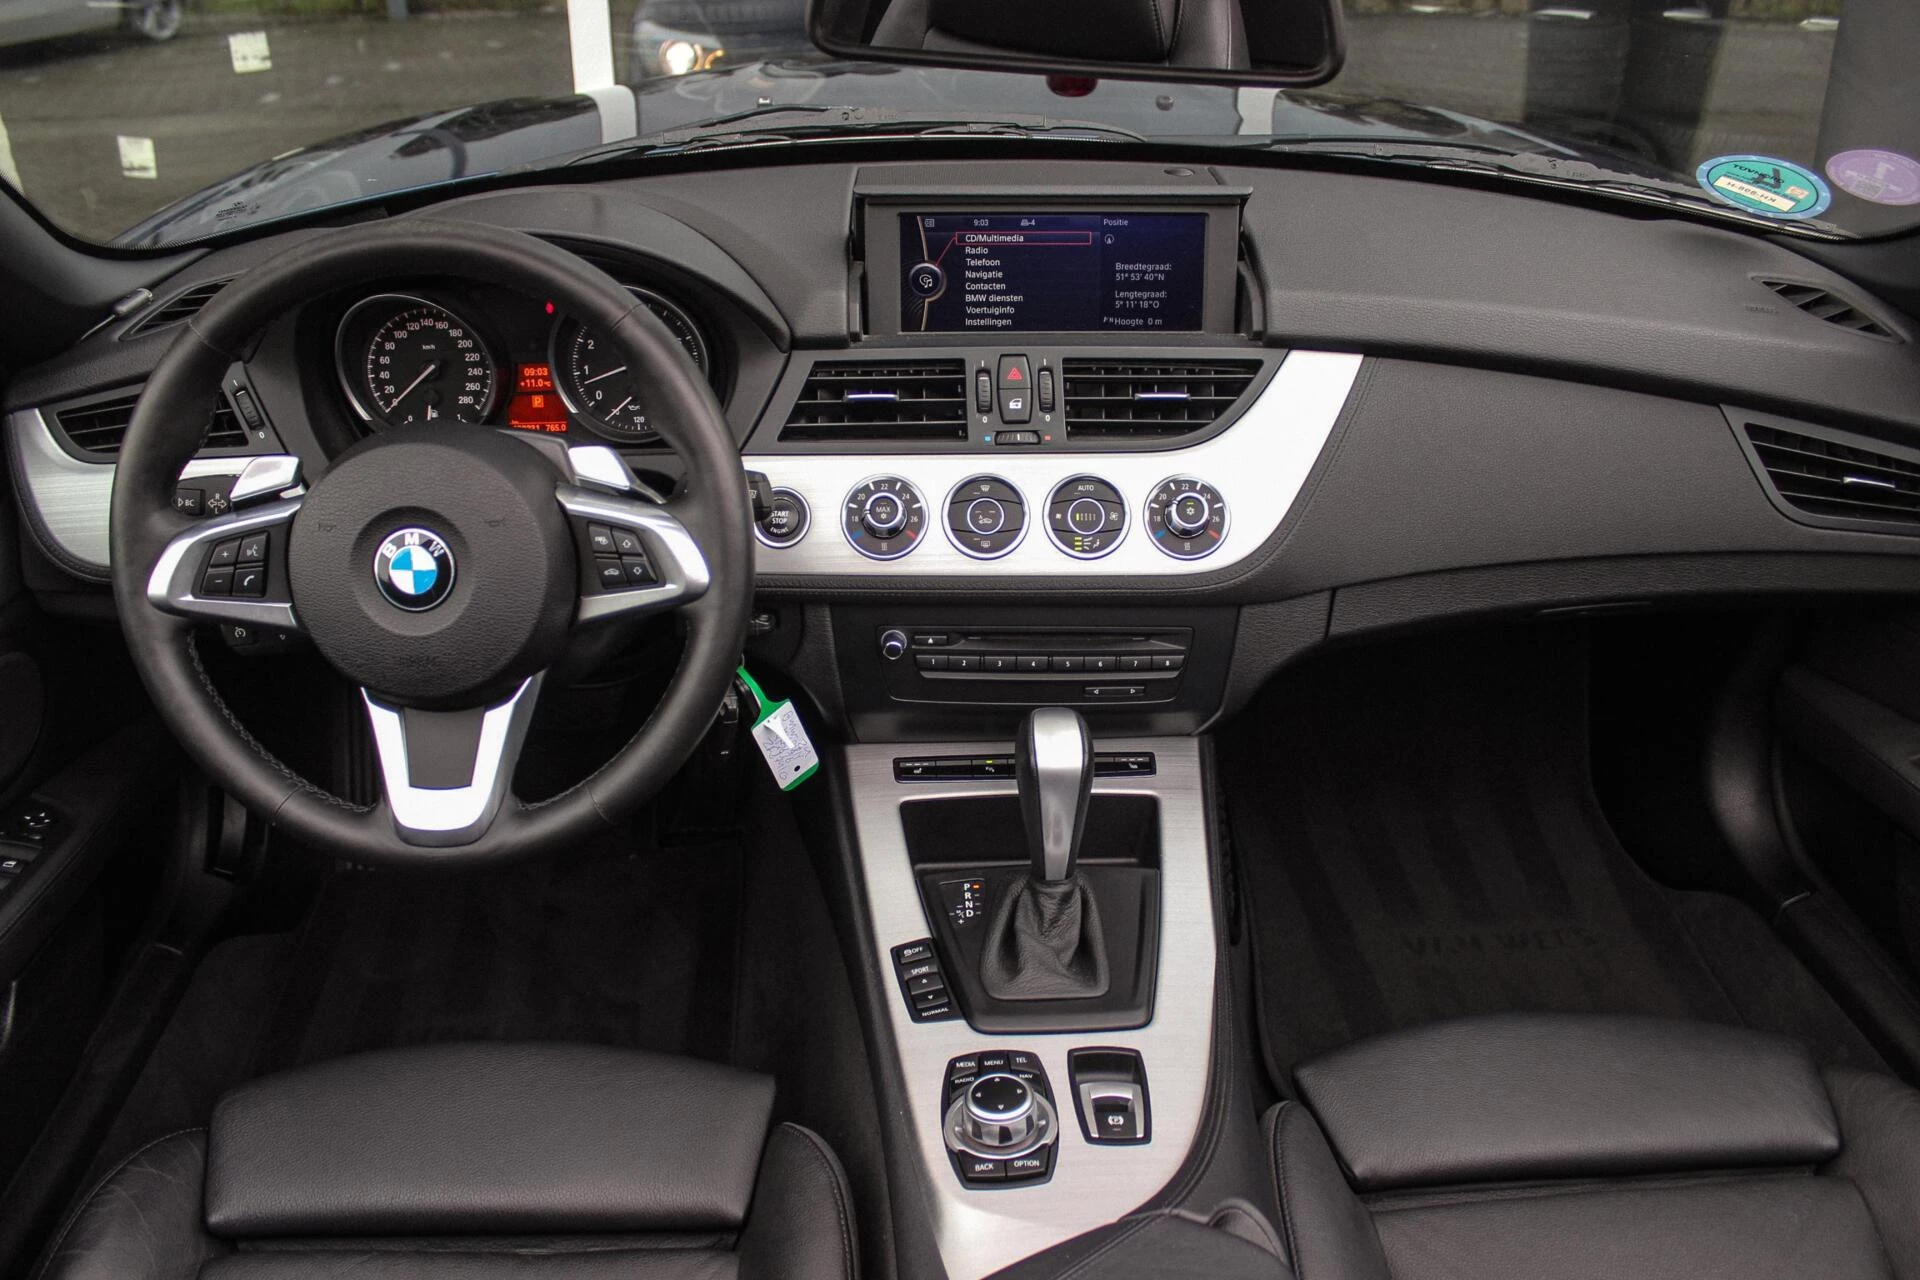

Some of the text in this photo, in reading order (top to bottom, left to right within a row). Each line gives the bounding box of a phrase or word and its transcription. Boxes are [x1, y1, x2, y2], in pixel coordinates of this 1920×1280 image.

[1103, 218, 1128, 226] Positie
[965, 234, 1024, 242] CD/Multimedia
[965, 246, 988, 254] Radio
[966, 258, 1000, 266] Telefoon
[1115, 262, 1172, 272] Breedtegraad:
[965, 270, 1003, 280] Navigatie
[965, 282, 1006, 290] Contacten
[988, 294, 1024, 302] diensten
[1115, 290, 1167, 299] Lengtegraad:
[966, 306, 1015, 315] Voertuiginfo
[420, 318, 434, 326] 140
[434, 321, 449, 329] 160
[965, 318, 1012, 327] Instellingen
[1114, 317, 1144, 327] Hoogte
[1147, 317, 1153, 326] 0
[406, 322, 420, 331] 120
[393, 330, 408, 339] 100
[449, 328, 463, 337] 180
[384, 342, 395, 350] 80
[457, 340, 473, 348] 200
[587, 339, 595, 350] 2
[379, 356, 390, 364] 60
[465, 353, 480, 361] 220
[467, 368, 483, 376] 240
[524, 367, 549, 377] 09:03
[583, 365, 589, 374] 1
[379, 371, 390, 379] 40
[384, 385, 395, 394] 20
[465, 382, 480, 391] 260
[595, 390, 603, 400] 0
[458, 395, 474, 404] 280
[545, 424, 567, 432] 765.0
[184, 499, 195, 507] BC
[772, 517, 788, 525] STOP
[770, 526, 789, 534] ENGINE
[382, 532, 445, 558] BMW
[964, 883, 971, 891] P
[964, 892, 972, 900] R
[966, 909, 974, 917] D
[911, 946, 924, 954] OFF
[910, 965, 929, 976] SPORT
[921, 1007, 949, 1017] NORMAL
[954, 1076, 975, 1084] RADIO
[974, 1163, 994, 1172] BACK
[1013, 1160, 1040, 1168] OPTION
